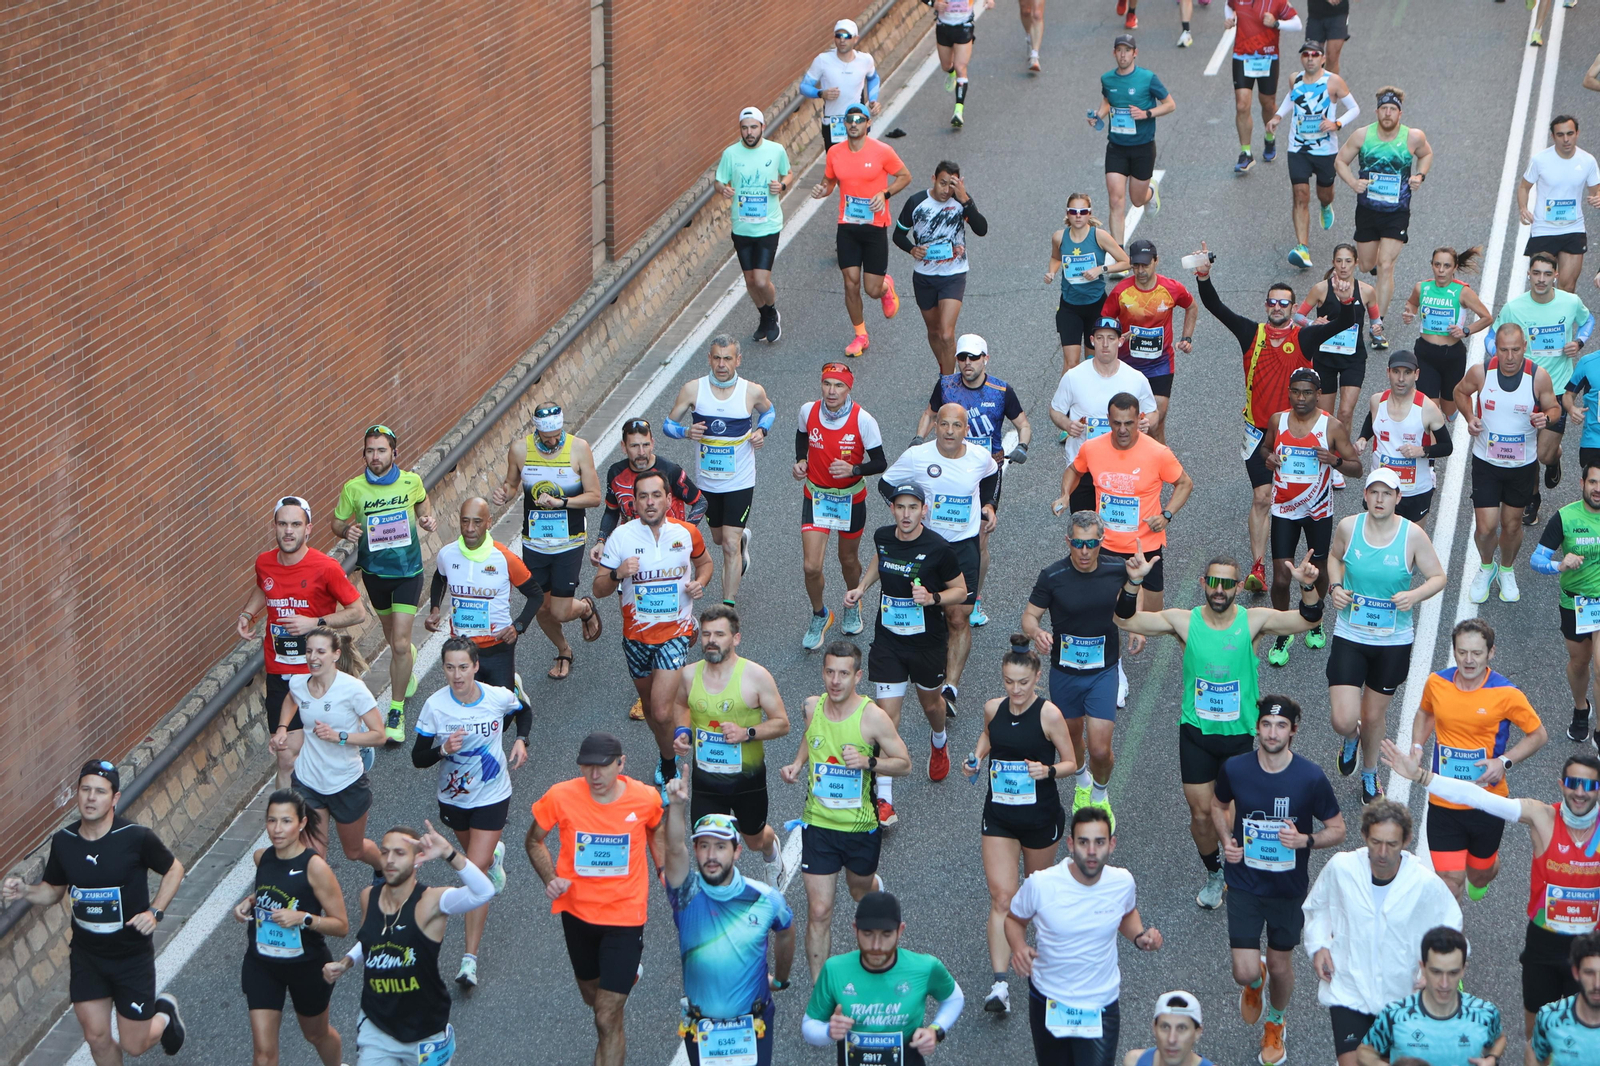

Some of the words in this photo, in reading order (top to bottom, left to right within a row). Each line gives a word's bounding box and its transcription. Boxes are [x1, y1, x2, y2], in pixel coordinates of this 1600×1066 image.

[1421, 297, 1454, 307] PORTUGAL
[709, 446, 732, 454] ZURICH
[382, 514, 403, 523] ZURICH
[540, 512, 562, 520] ZURICH
[394, 533, 408, 541] SOUSA
[289, 597, 309, 608] TRAIL
[276, 608, 296, 618] TEAM
[466, 724, 473, 732] DO
[474, 720, 499, 738] TEJO
[1454, 751, 1480, 759] ZURICH
[594, 837, 624, 846] ZURICH
[1260, 846, 1277, 854] 6280
[594, 851, 611, 859] 5225
[1565, 892, 1595, 900] ZURICH
[86, 906, 104, 914] 3285
[1566, 906, 1580, 914] 964
[268, 929, 284, 938] 4179
[370, 976, 420, 994] SEVILLA
[717, 1019, 746, 1030] ZURICH
[718, 1038, 736, 1046] 6345
[863, 1038, 894, 1046] ZURICH
[730, 1048, 748, 1056] CHICO
[863, 1053, 882, 1062] 2917
